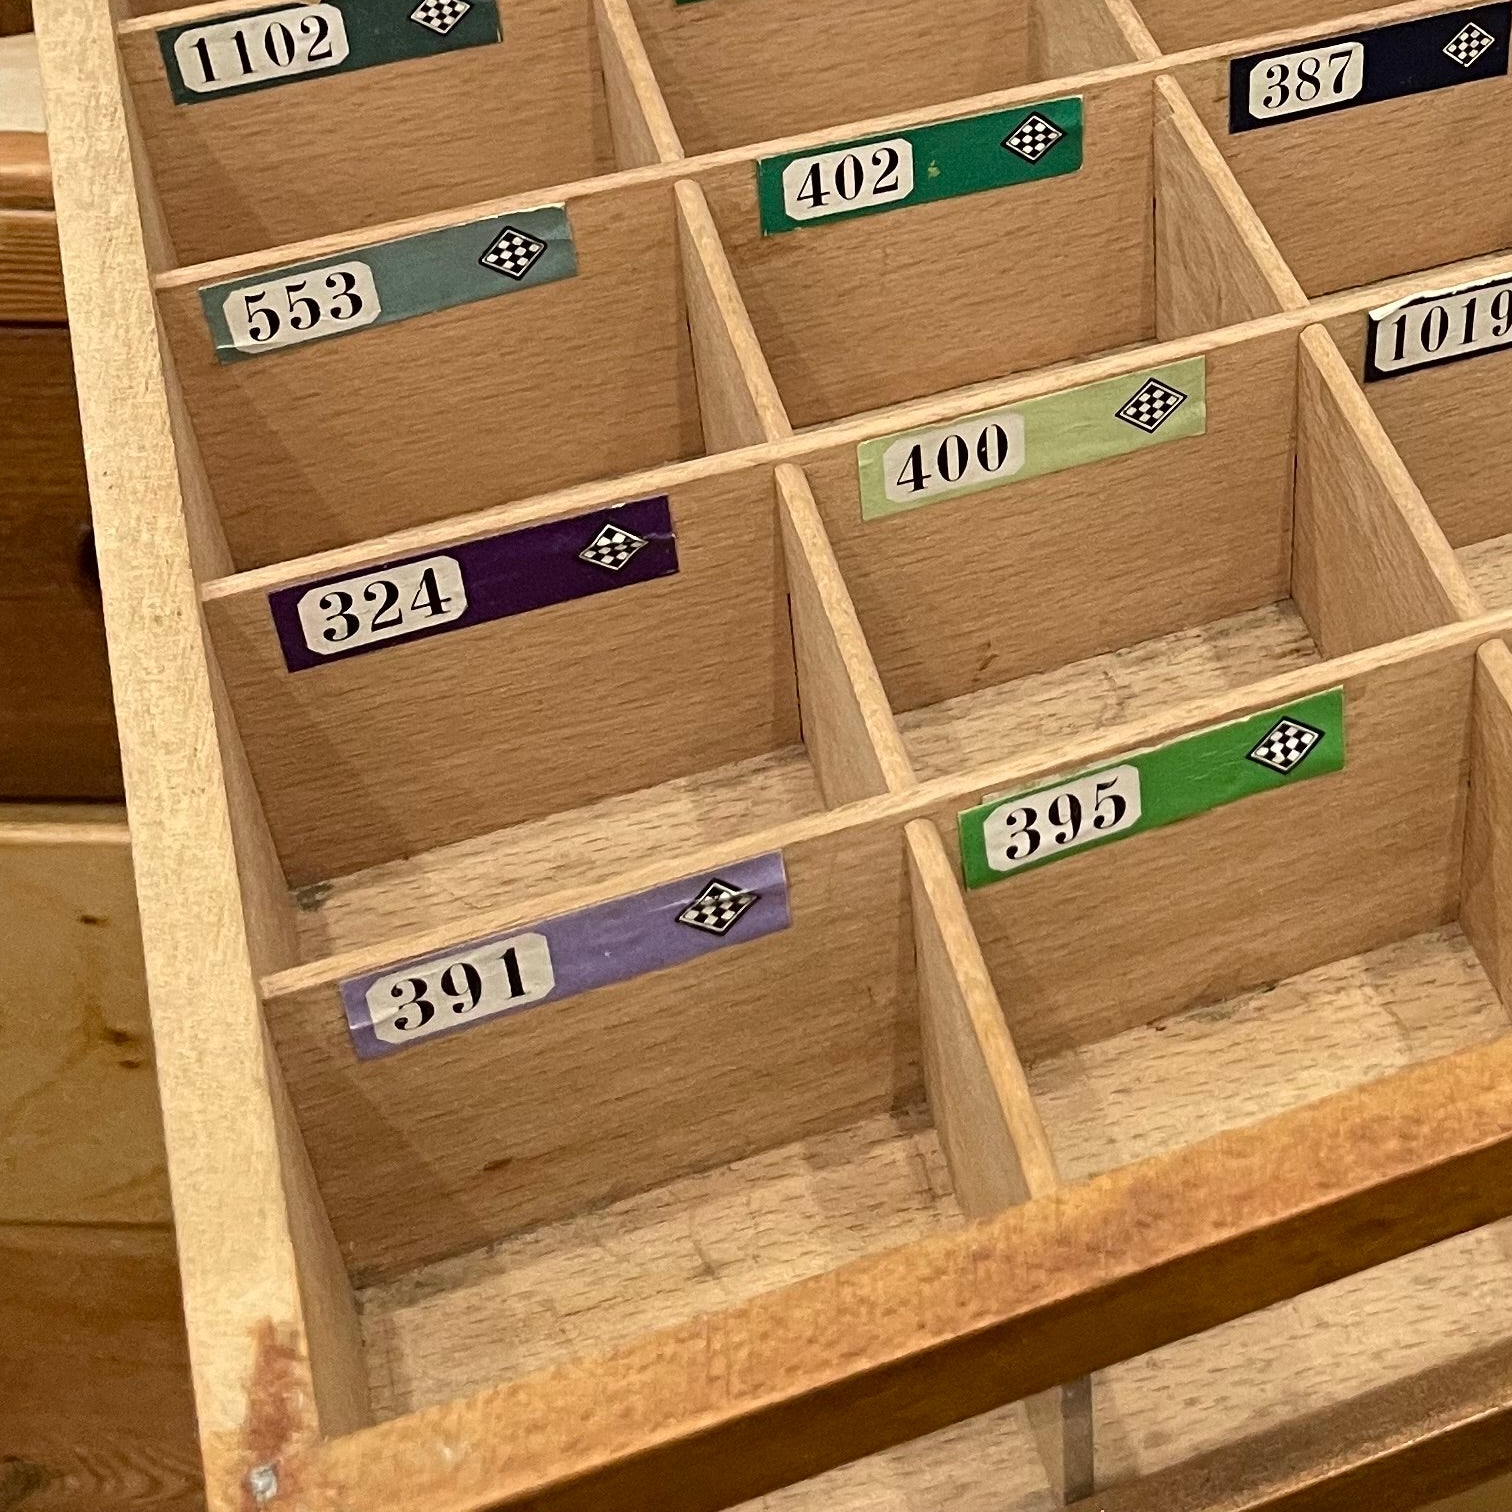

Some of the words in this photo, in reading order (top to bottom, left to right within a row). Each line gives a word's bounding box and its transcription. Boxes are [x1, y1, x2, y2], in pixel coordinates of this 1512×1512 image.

[191, 15, 333, 83] 1102
[1262, 49, 1353, 109] 387
[796, 147, 899, 209] 402
[244, 271, 363, 342] 553
[896, 423, 1010, 493] 400
[319, 567, 452, 642] 324
[1005, 777, 1127, 861] 395
[391, 949, 529, 1032] 391
